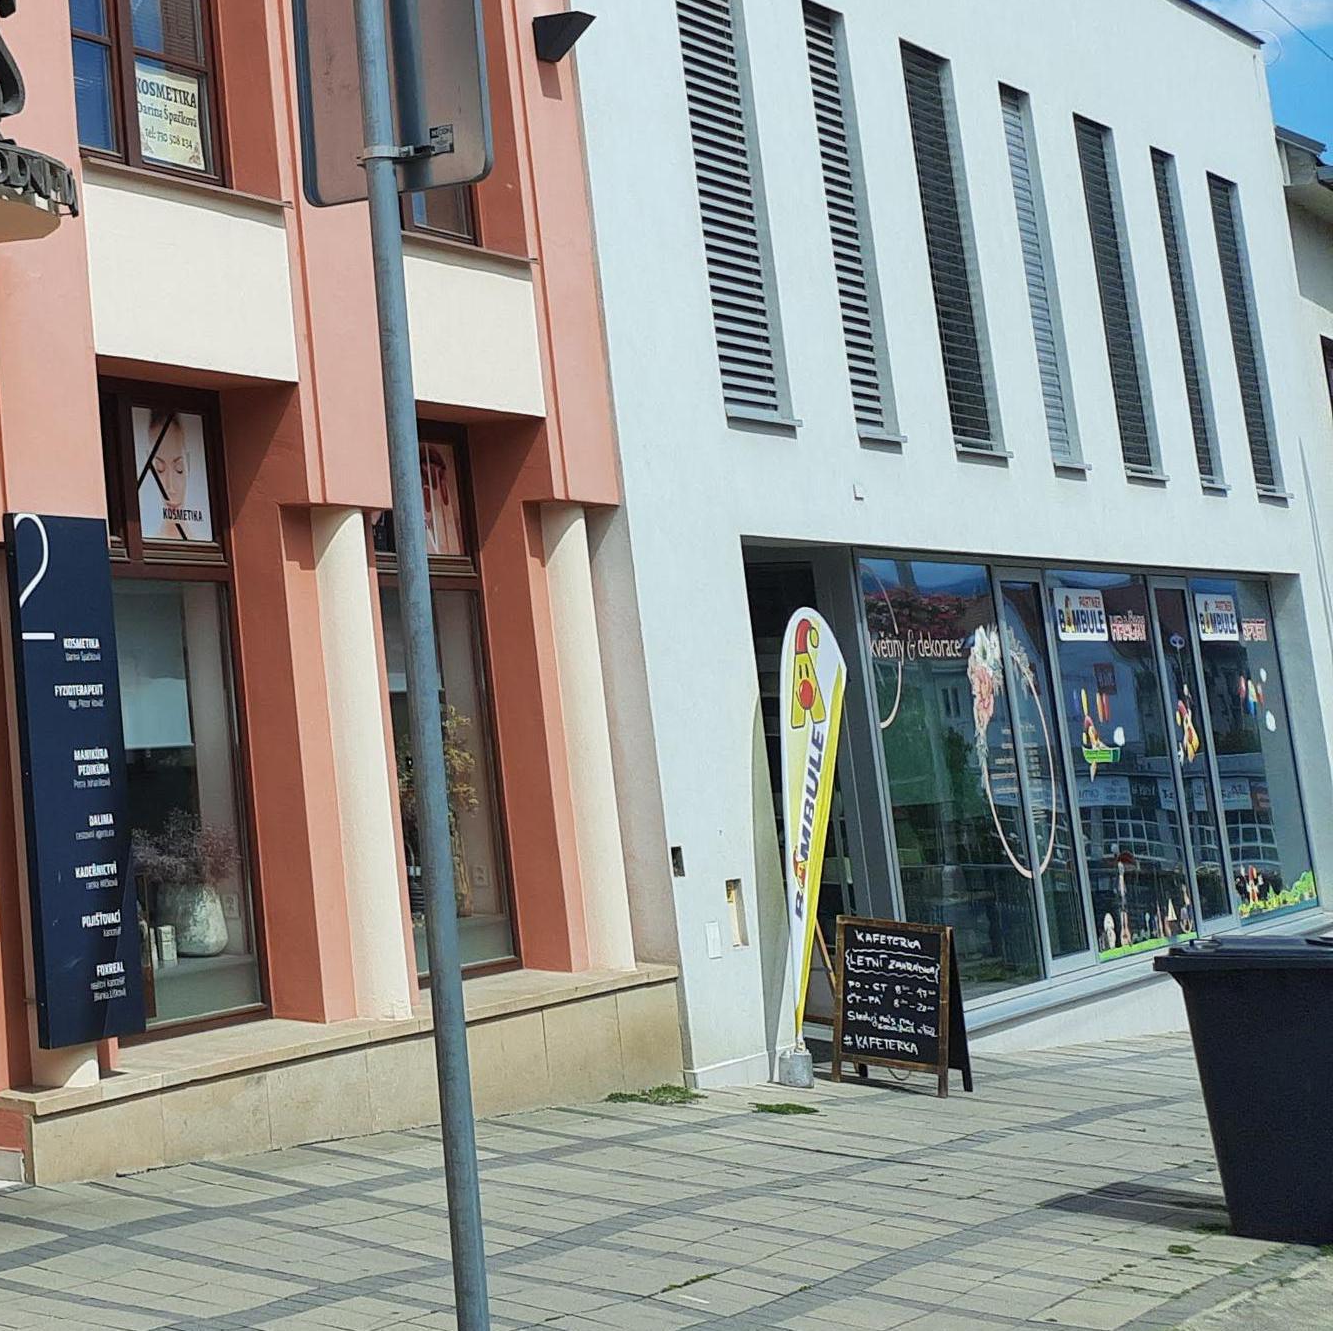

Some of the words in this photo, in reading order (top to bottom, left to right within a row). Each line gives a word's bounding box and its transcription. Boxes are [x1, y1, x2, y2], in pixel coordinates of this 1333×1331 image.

[136, 77, 196, 108] KOSMETIKA
[163, 507, 203, 522] KOSMETIKA
[918, 631, 962, 657] dekorace
